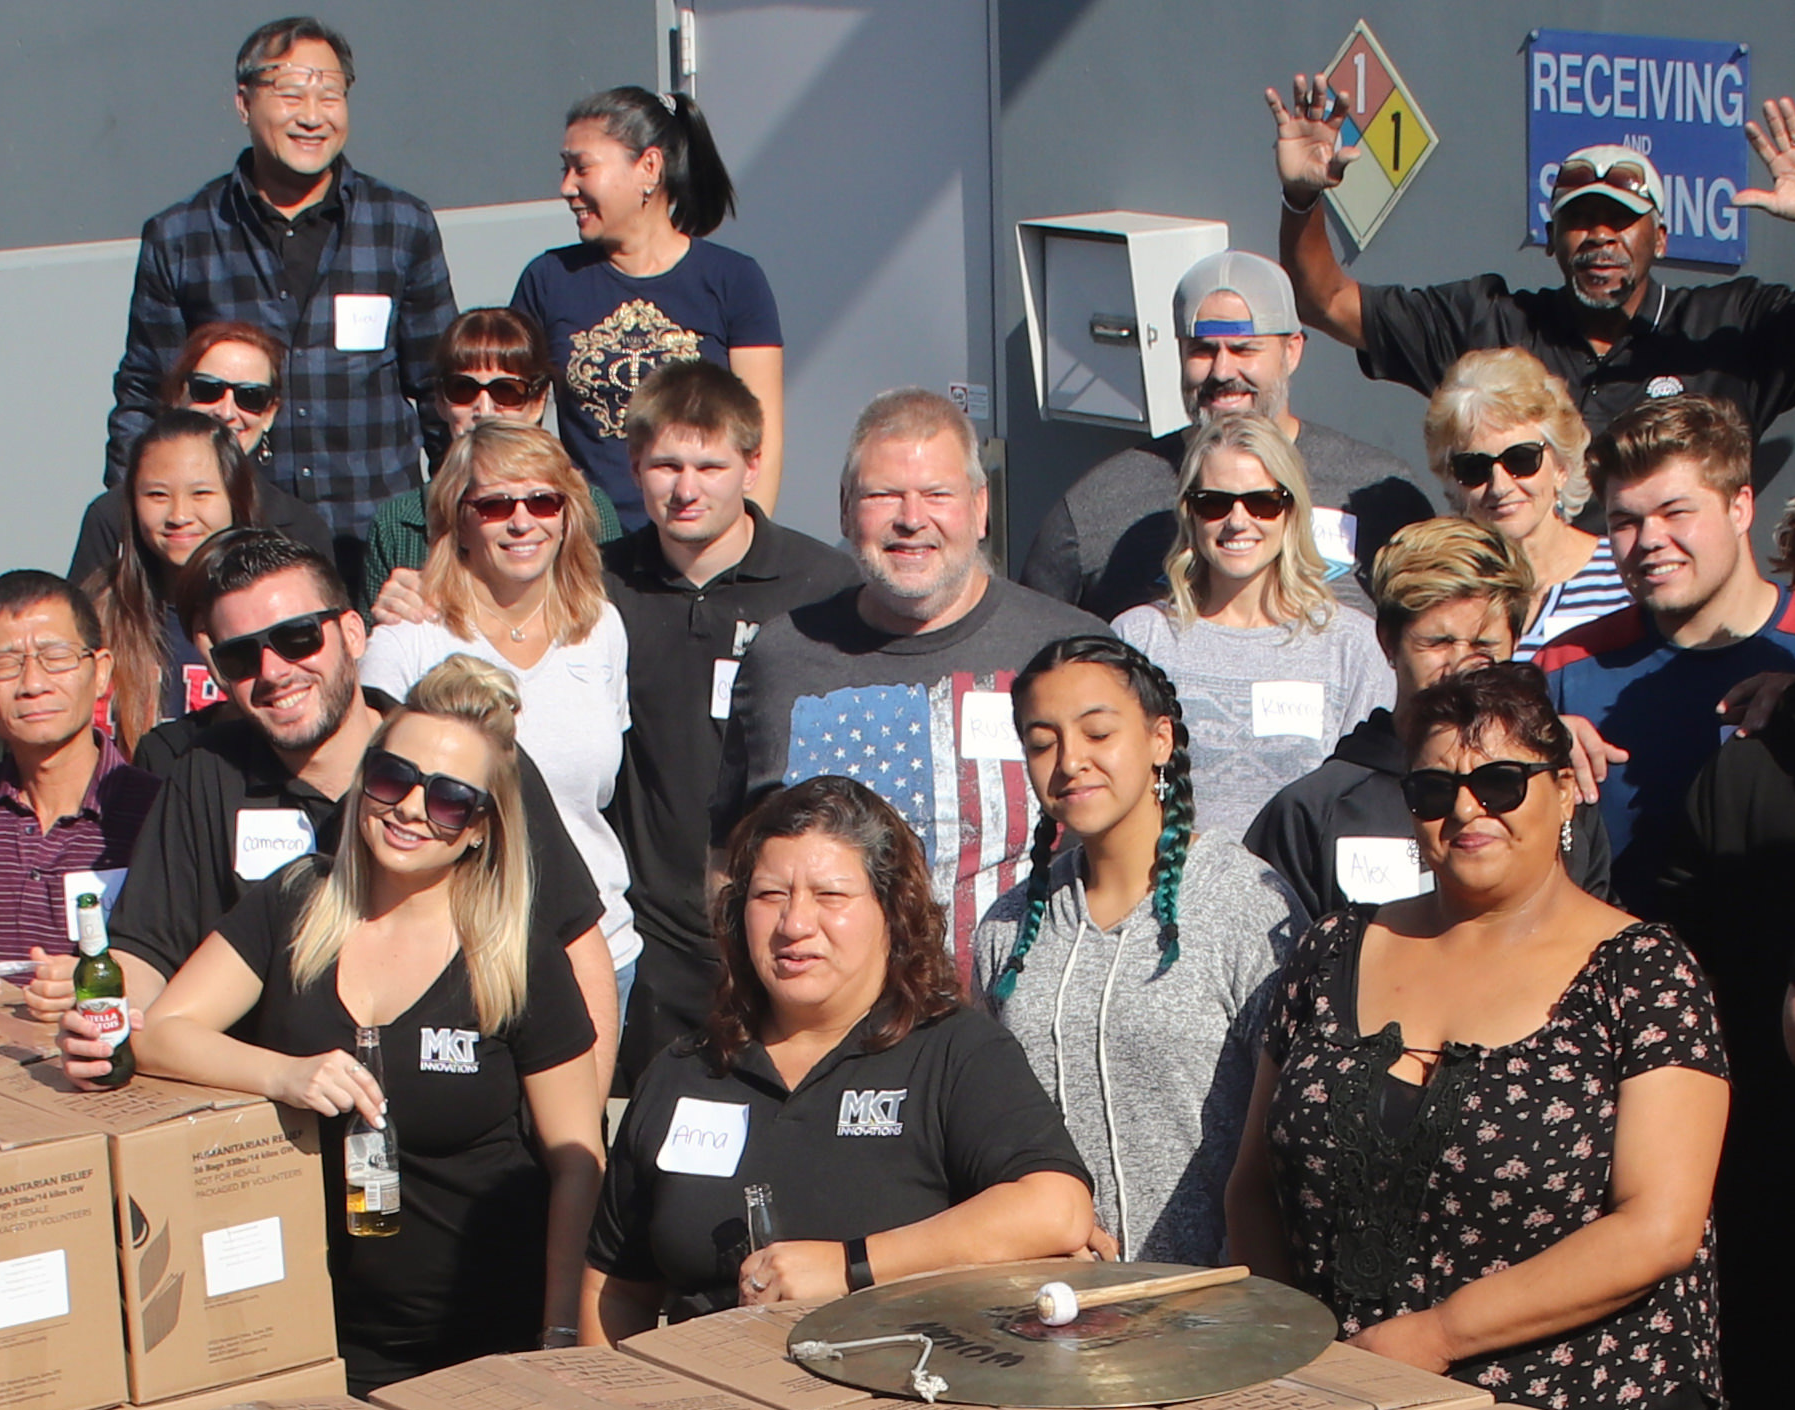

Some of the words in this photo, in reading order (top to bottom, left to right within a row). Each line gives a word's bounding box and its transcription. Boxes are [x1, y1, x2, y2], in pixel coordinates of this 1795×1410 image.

[1354, 52, 1367, 115] 1
[1533, 52, 1744, 127] RECEIVING
[1391, 111, 1402, 171] 1
[1621, 134, 1652, 154] AND
[1351, 852, 1396, 888] Alex
[420, 1027, 480, 1063] MKT
[839, 1088, 908, 1125] MKT
[672, 1125, 729, 1149] Anna
[837, 1124, 903, 1137] INNOVATIONS
